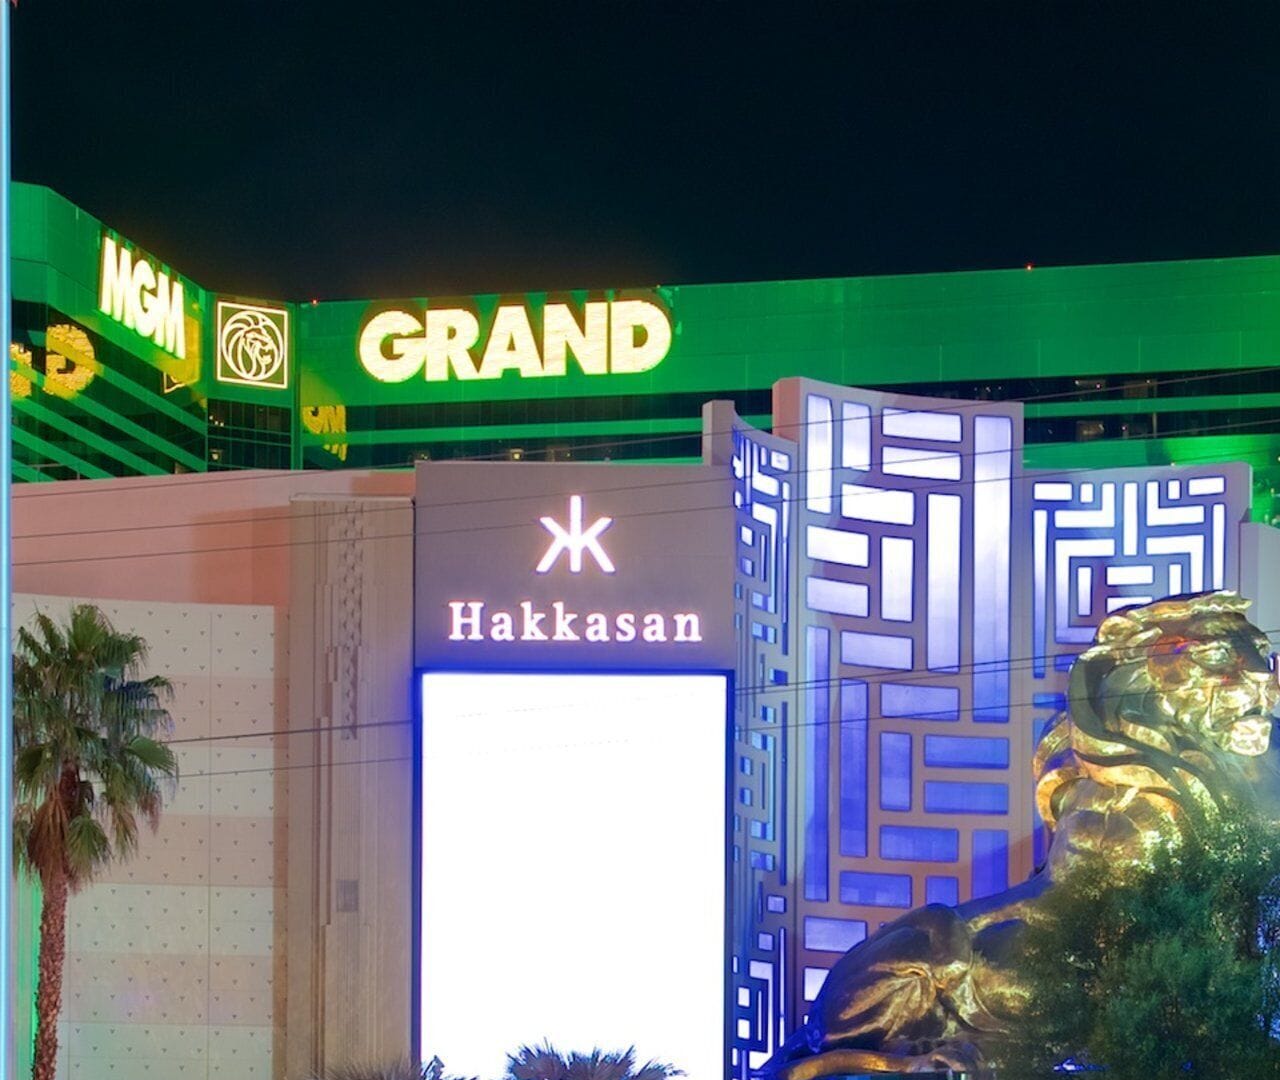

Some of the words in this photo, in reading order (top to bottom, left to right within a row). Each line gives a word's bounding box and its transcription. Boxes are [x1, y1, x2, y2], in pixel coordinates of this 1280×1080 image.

[99, 236, 187, 360] MGM
[359, 300, 672, 382] GRAND
[448, 601, 703, 642] Hakkasan
